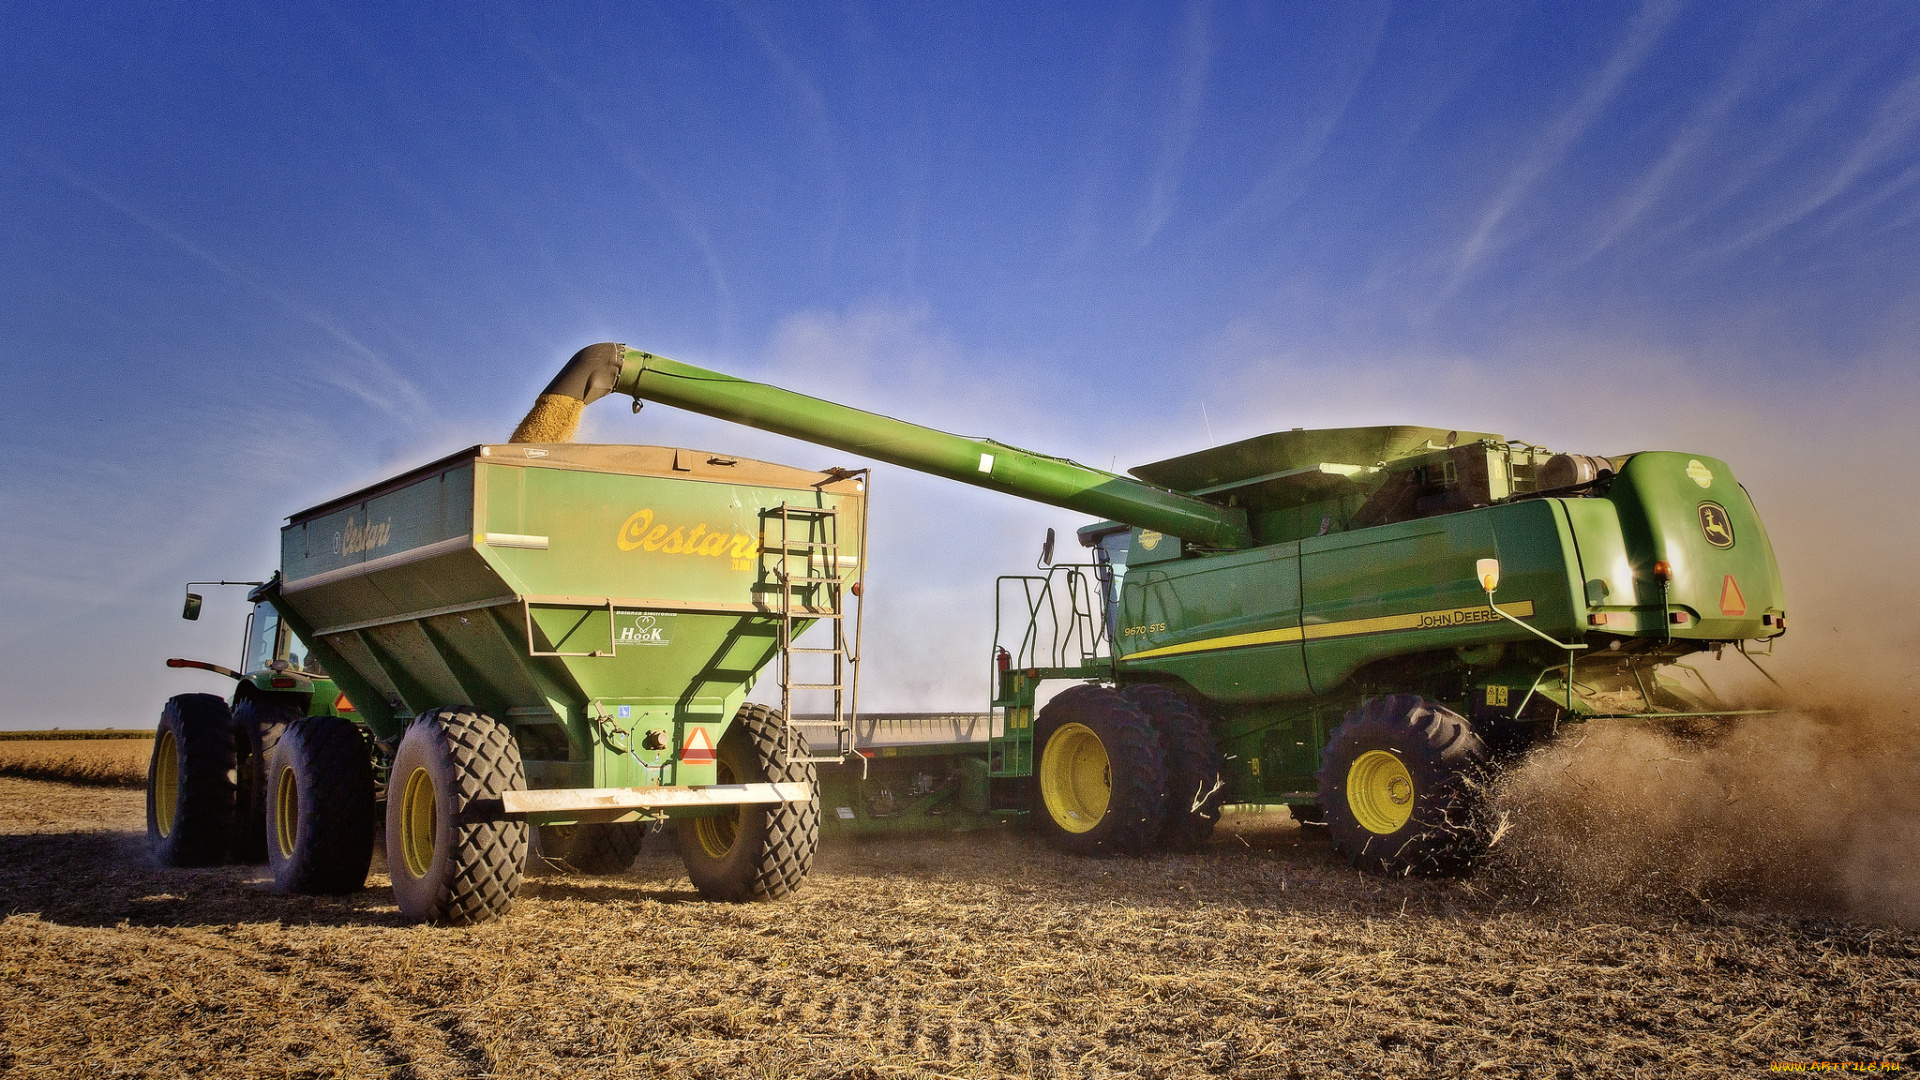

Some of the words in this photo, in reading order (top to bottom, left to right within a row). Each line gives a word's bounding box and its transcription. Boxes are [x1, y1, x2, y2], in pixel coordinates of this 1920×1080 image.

[342, 516, 392, 556] Cestari
[617, 509, 765, 559] Cestari
[1124, 626, 1146, 636] 9670
[1149, 622, 1166, 633] STS
[1417, 614, 1451, 627] JOHN
[1454, 609, 1499, 623] DEERE
